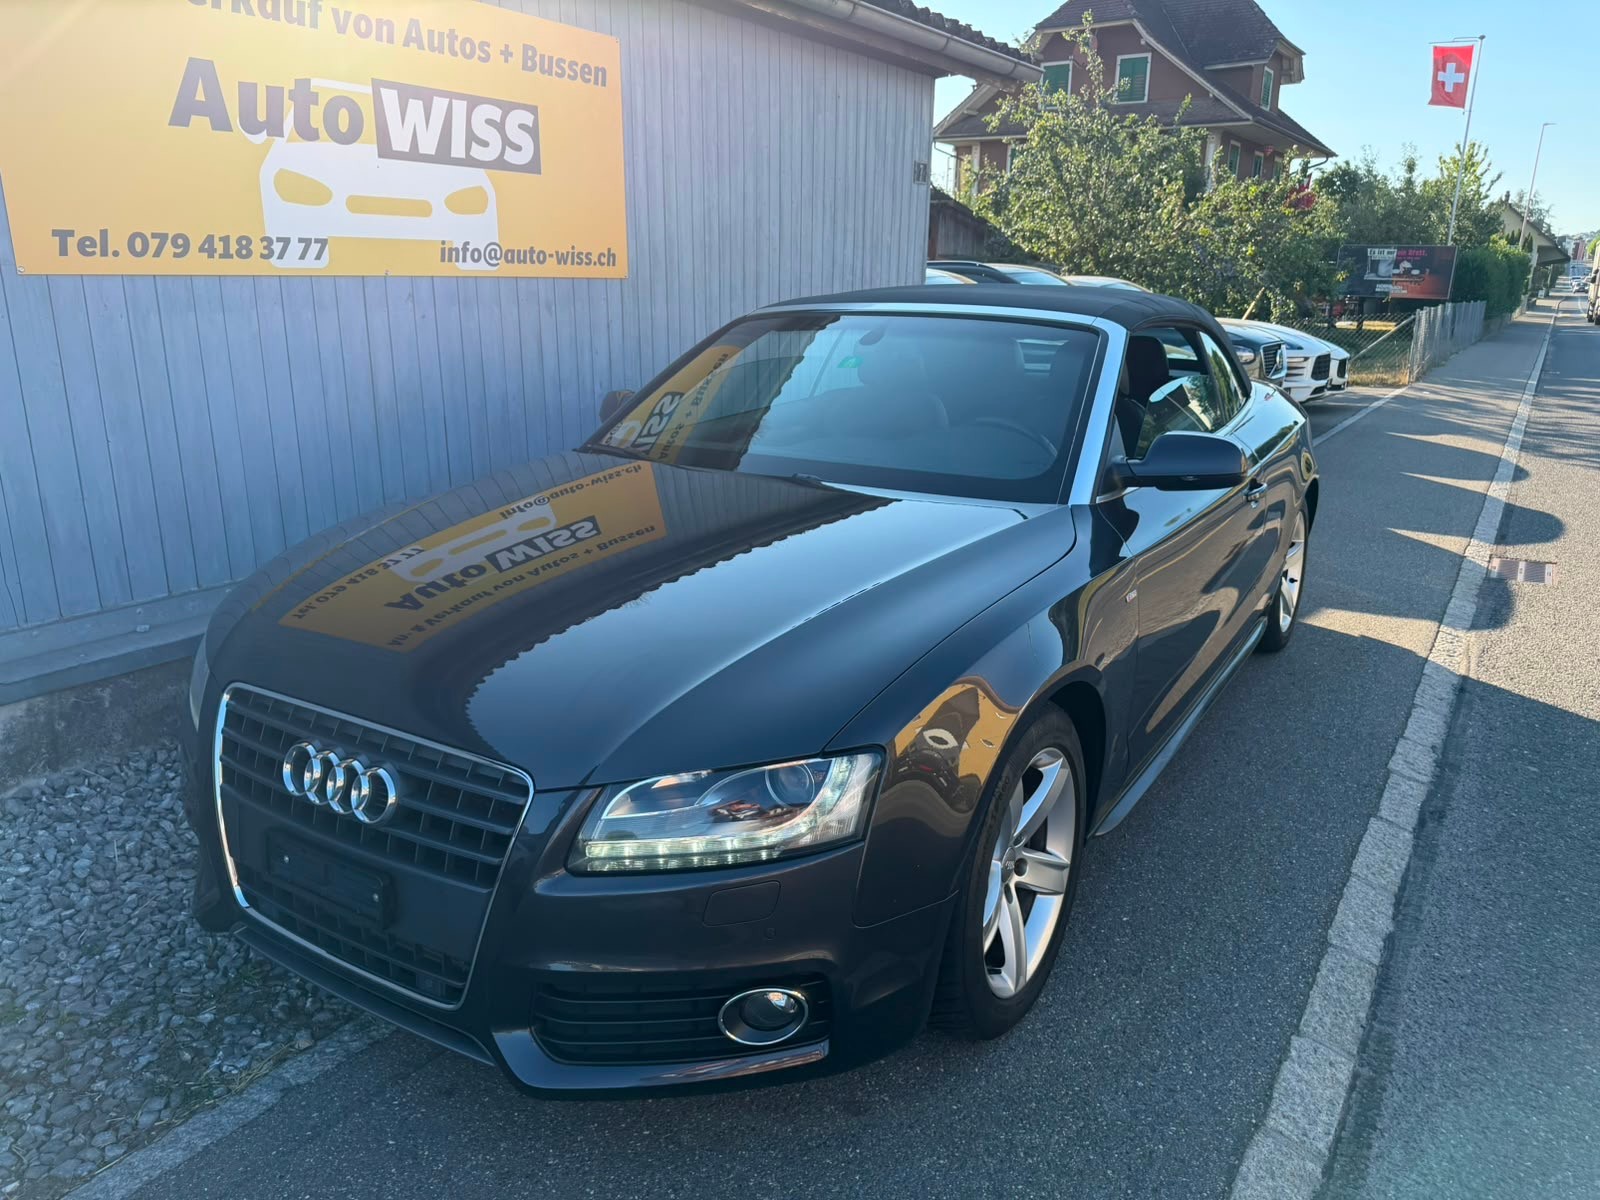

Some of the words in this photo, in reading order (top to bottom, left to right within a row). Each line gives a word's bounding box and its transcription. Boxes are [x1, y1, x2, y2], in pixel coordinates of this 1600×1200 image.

[331, 7, 395, 44] von
[402, 18, 491, 63] Autos
[499, 43, 513, 64] +
[521, 43, 607, 88] Bussen
[168, 57, 365, 145] Auto
[380, 87, 535, 165] WISS
[51, 228, 120, 258] Tel.
[127, 231, 191, 259] 079
[198, 234, 253, 260] 418
[259, 236, 291, 260] 37
[297, 236, 329, 261] 77
[440, 240, 616, 267] info@auto-wiss.ch
